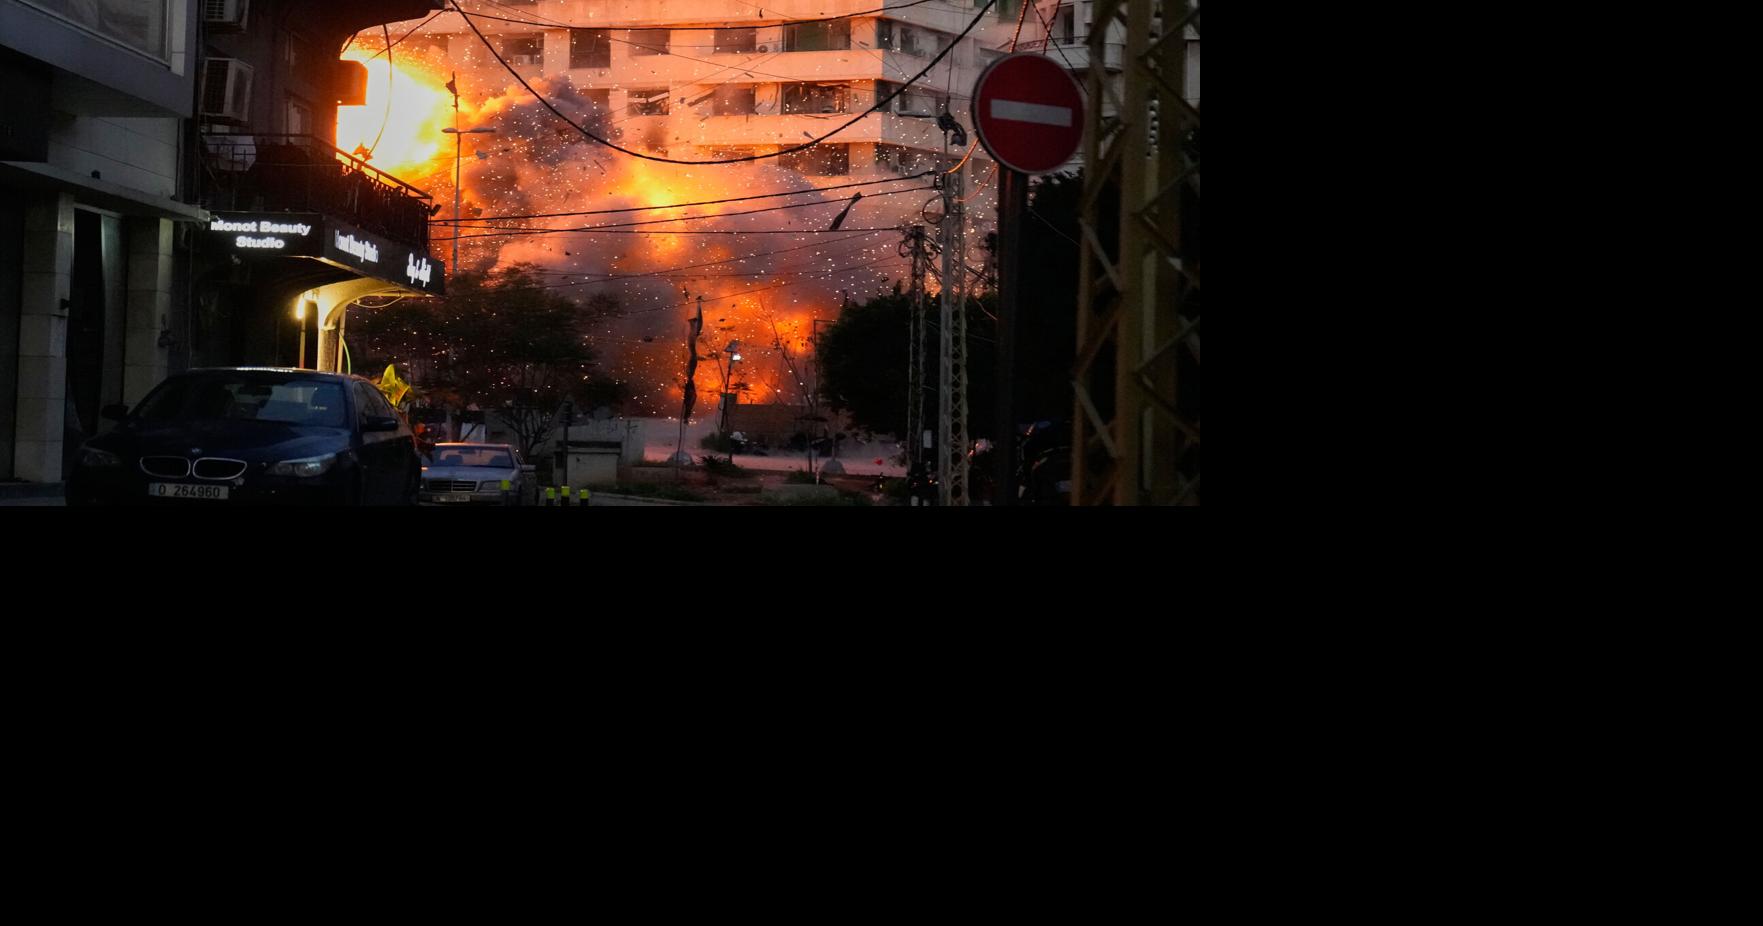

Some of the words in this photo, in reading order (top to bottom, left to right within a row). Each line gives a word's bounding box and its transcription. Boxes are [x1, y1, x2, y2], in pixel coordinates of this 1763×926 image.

[210, 220, 257, 232] Monot
[260, 221, 312, 236] Beauty
[236, 236, 285, 248] Studio
[174, 485, 220, 498] 264960
